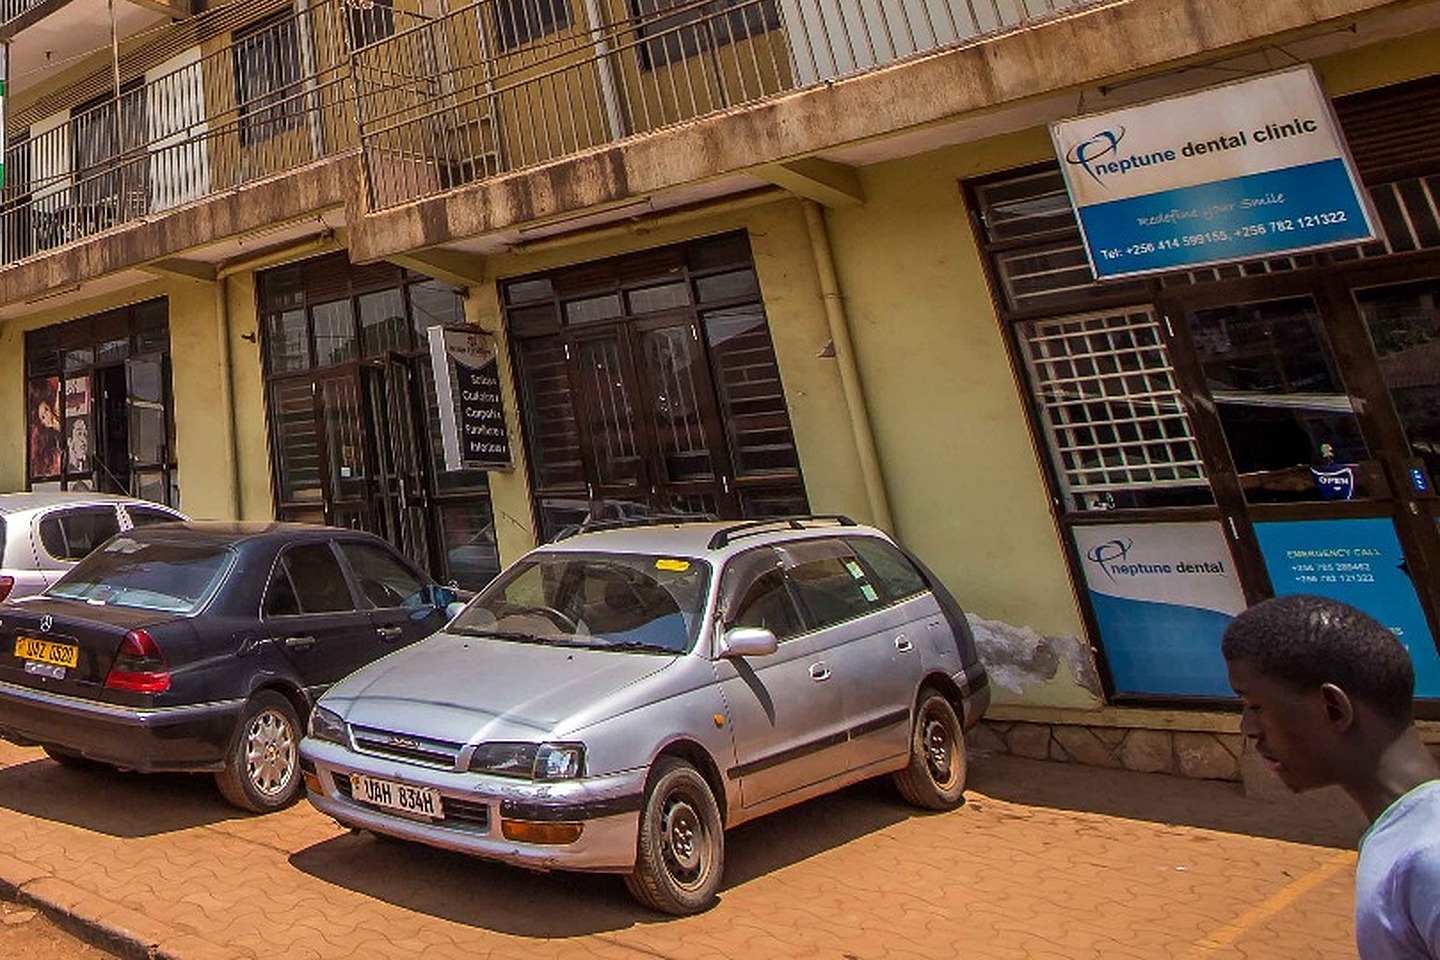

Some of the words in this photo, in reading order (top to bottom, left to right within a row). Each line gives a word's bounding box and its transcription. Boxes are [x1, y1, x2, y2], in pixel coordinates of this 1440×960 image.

[1095, 149, 1176, 176] neptune
[1181, 131, 1248, 158] dental
[1253, 118, 1318, 144] clinic
[1126, 242, 1155, 257] +256
[1234, 223, 1267, 238] +256
[1269, 219, 1295, 234] 782
[1297, 210, 1348, 229] 121322
[1319, 476, 1349, 485] OPEN
[1110, 562, 1172, 577] neptune
[1175, 561, 1225, 574] dental
[364, 779, 392, 804] UAH
[398, 786, 435, 815] 834H
